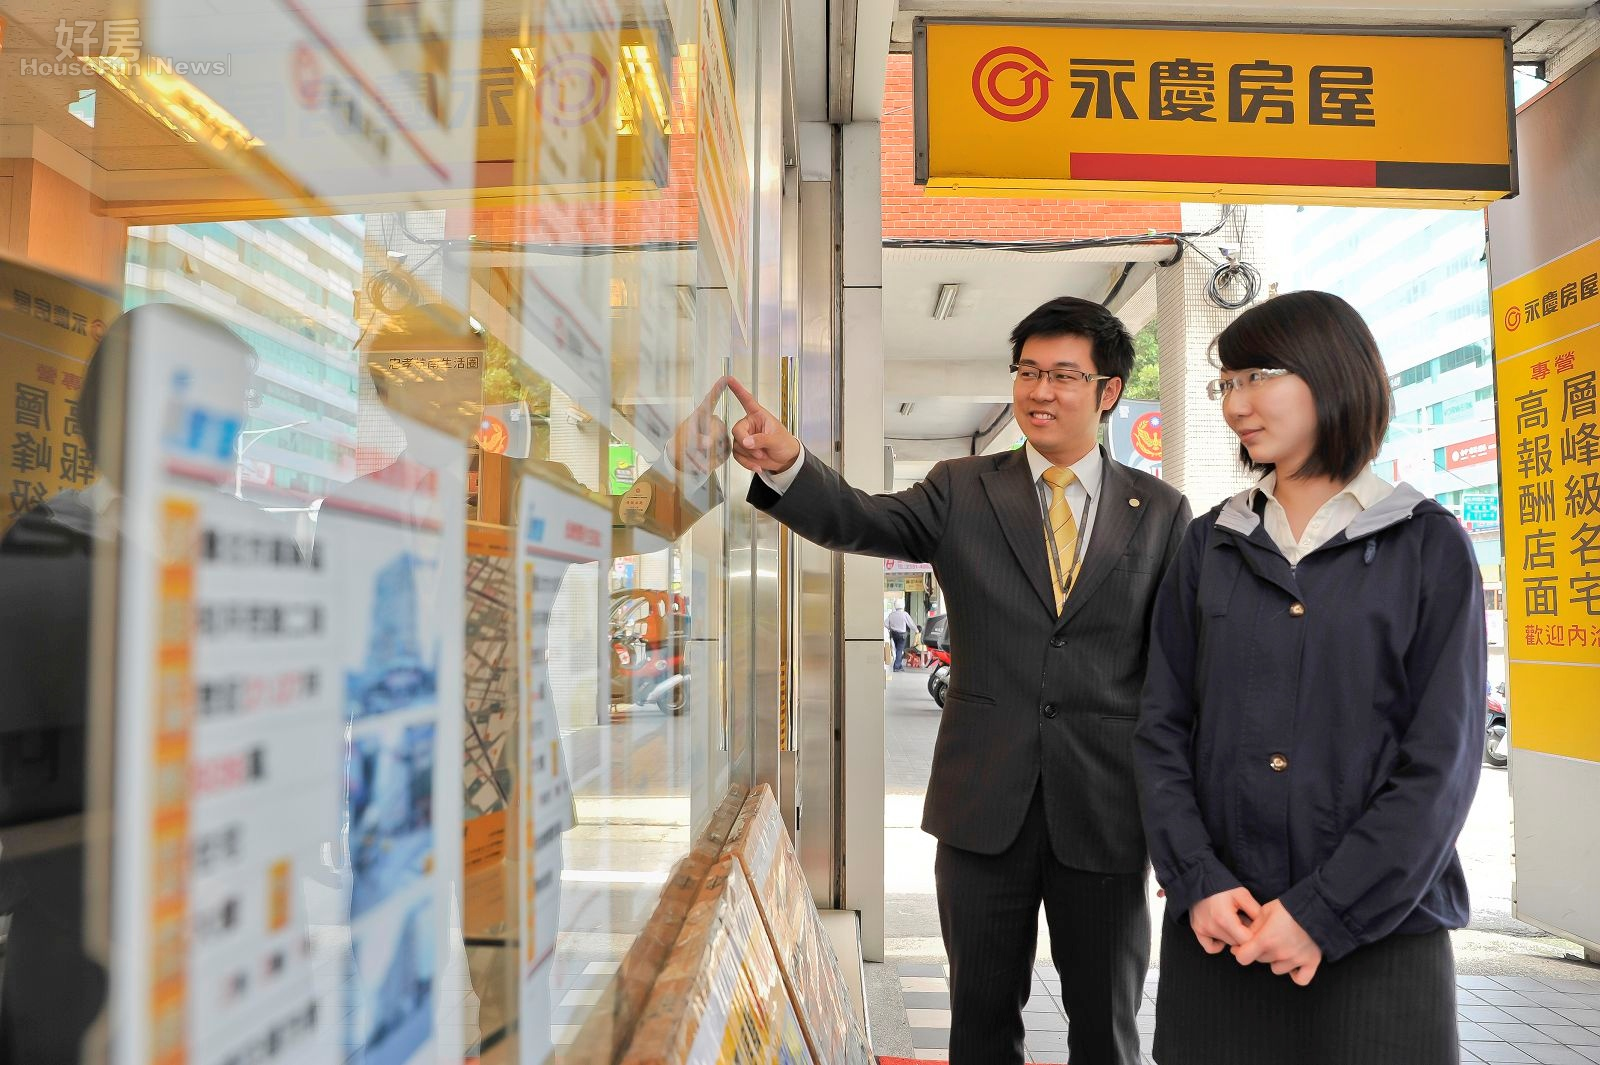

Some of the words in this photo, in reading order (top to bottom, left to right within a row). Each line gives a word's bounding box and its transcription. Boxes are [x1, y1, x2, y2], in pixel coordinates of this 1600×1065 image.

[1069, 57, 1376, 127] 永慶房屋
[1524, 272, 1599, 324] 永慶房屋
[1530, 351, 1576, 381] 專營
[1515, 388, 1559, 617] 高報酬店面
[1561, 370, 1600, 616] 層峰級名宅
